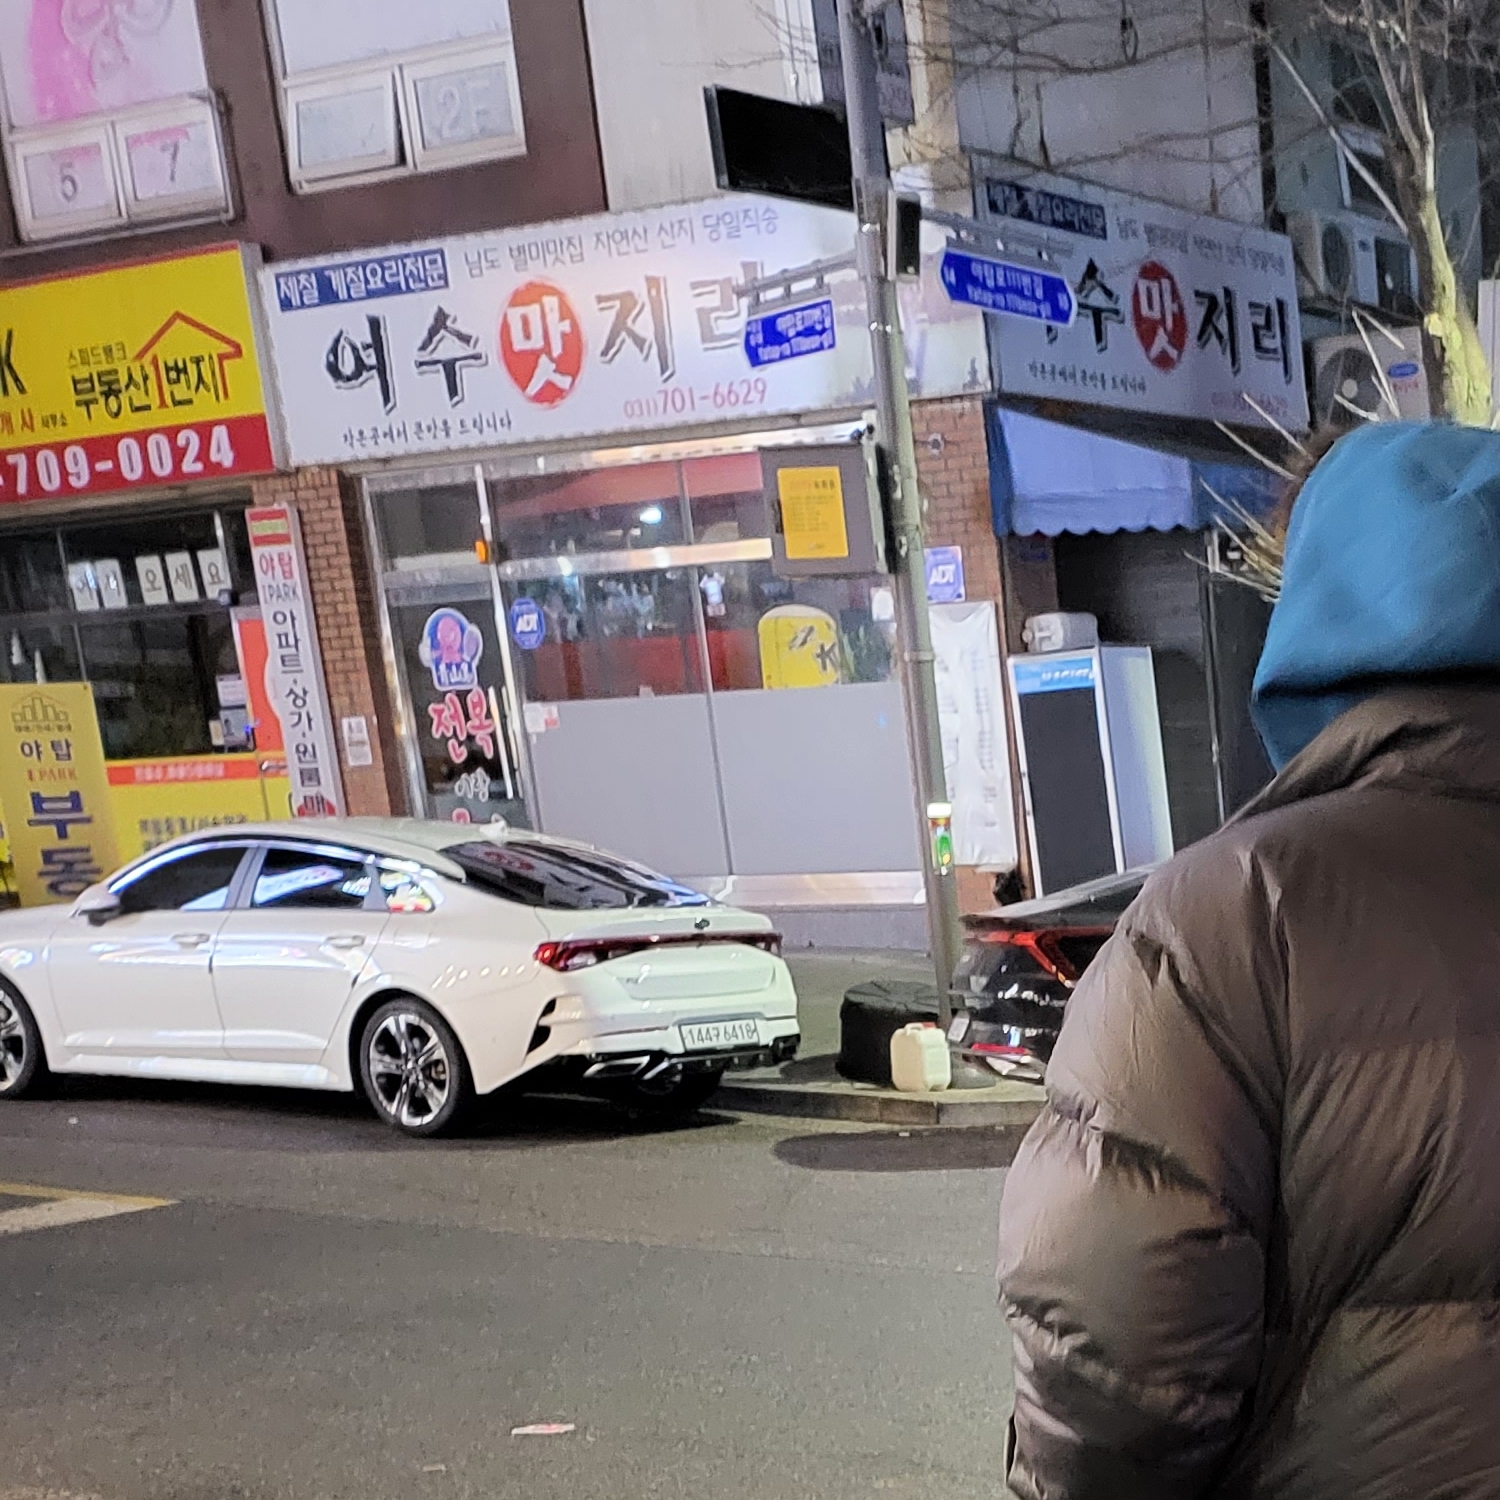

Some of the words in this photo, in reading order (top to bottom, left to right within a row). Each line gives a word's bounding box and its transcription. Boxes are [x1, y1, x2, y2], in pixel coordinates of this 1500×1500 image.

[464, 247, 502, 279] 남도
[508, 236, 585, 272] 별미맛집
[593, 228, 650, 257] 자연산
[656, 218, 696, 249] 산지
[702, 206, 779, 242] 당일직송
[1047, 257, 1293, 386] 수맛지리
[0, 424, 236, 496] 709-0024
[929, 563, 957, 585] ADT
